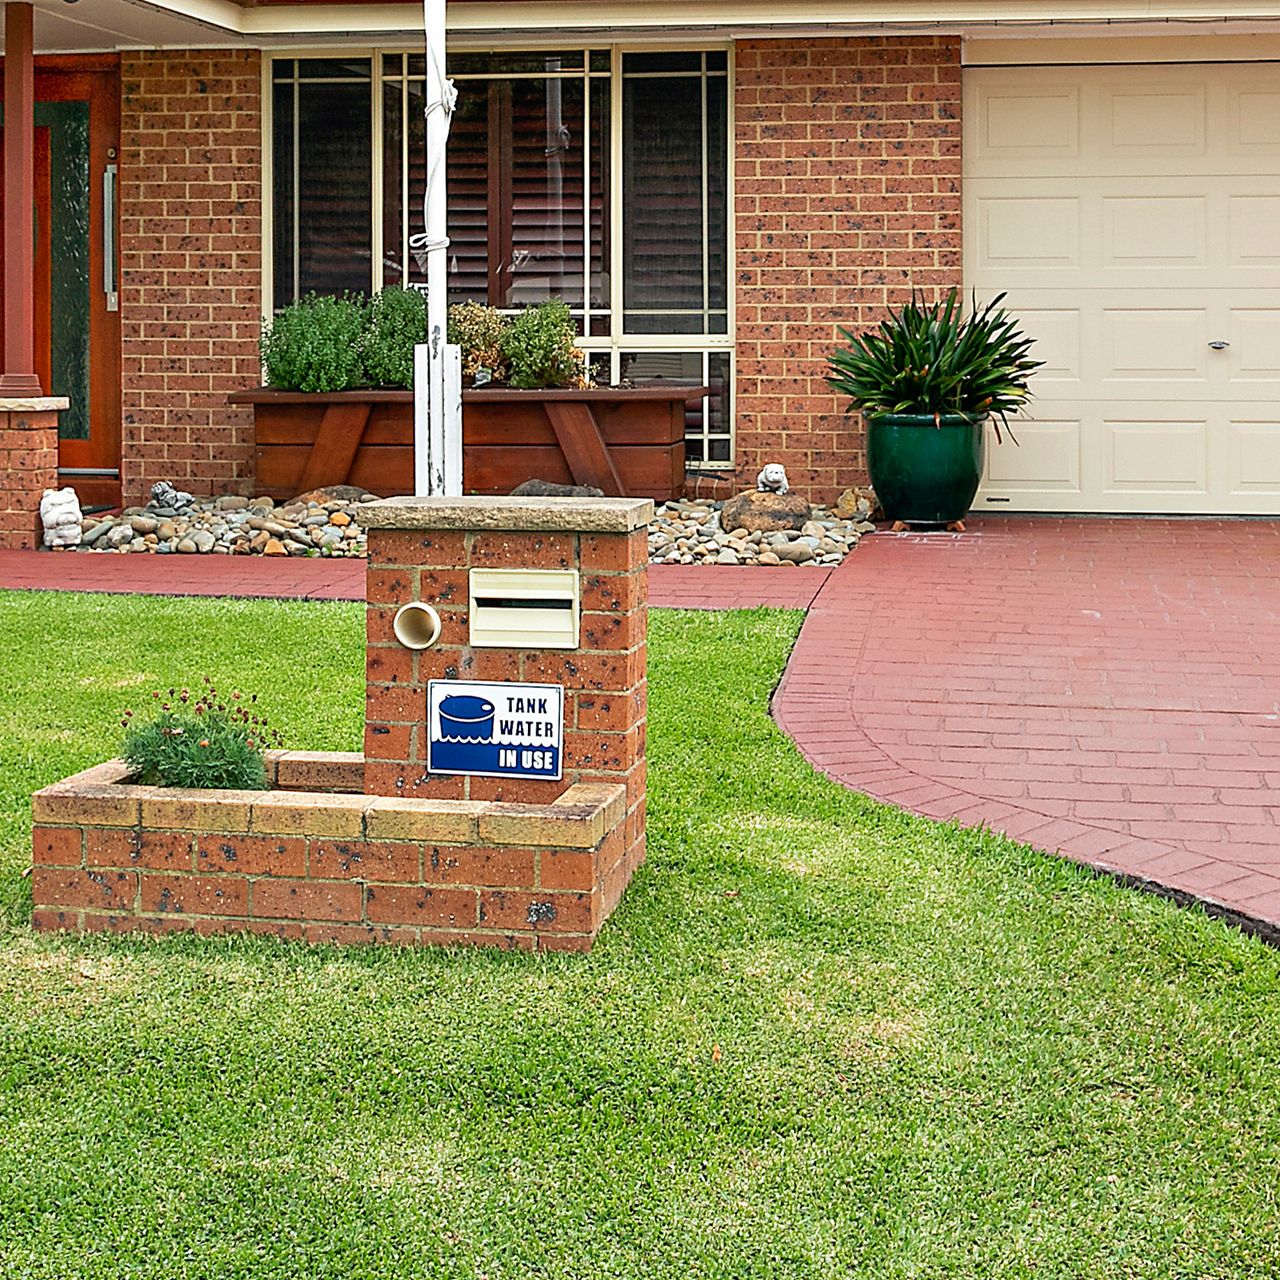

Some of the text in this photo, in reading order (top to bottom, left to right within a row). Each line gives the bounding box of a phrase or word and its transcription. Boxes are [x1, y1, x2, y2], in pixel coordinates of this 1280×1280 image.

[506, 697, 547, 714] TANK
[499, 720, 553, 737] WATER
[499, 749, 553, 770] IN USE
